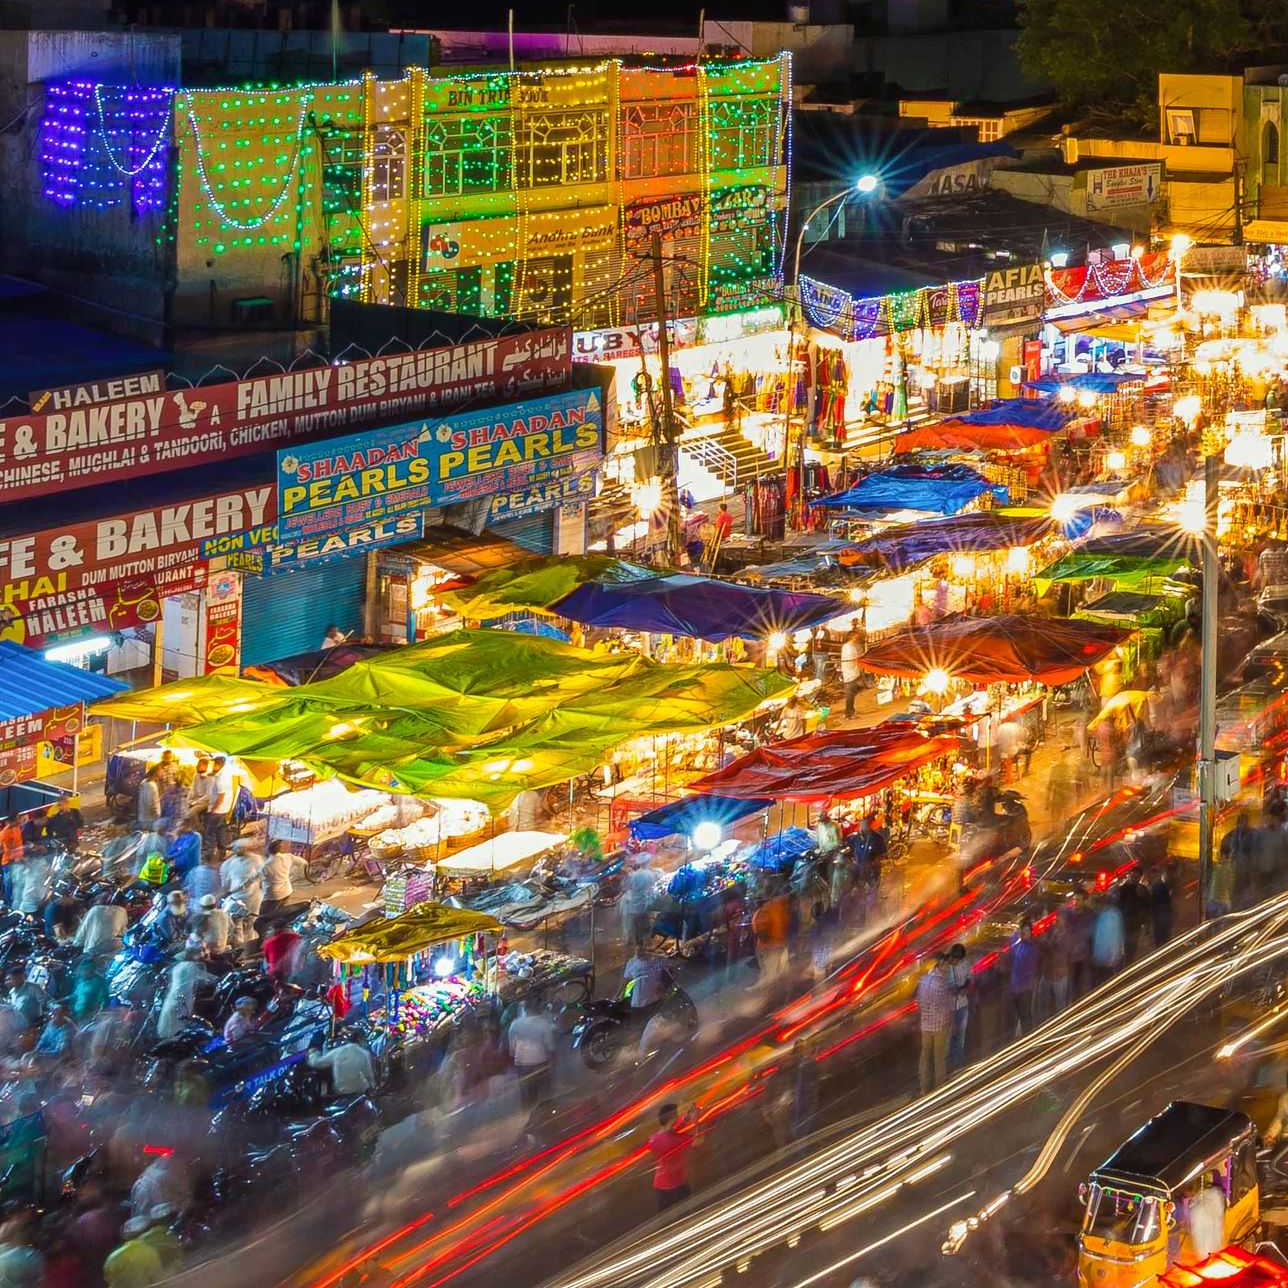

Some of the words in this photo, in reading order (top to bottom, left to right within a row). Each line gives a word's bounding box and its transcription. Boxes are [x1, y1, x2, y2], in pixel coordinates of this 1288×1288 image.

[449, 91, 473, 106] BIN
[641, 198, 700, 225] BOMBAY
[529, 228, 577, 244] Andhra
[581, 224, 614, 240] Bank
[987, 283, 1044, 305] PEARLS
[988, 264, 1043, 291] AFIA
[13, 425, 38, 461] &
[46, 397, 166, 455] BAKERY
[210, 405, 221, 426] A
[237, 368, 331, 420] FAMILY
[338, 340, 498, 401] RESTAURANT
[54, 374, 161, 410] HALEEM
[69, 448, 135, 477] MUGHLAI
[140, 445, 149, 463] &
[154, 430, 226, 458] TANDOORI,
[230, 420, 291, 446] CHICKEN,
[294, 409, 346, 433] MUTTON
[350, 403, 376, 422] DUM
[379, 393, 425, 416] BIRYANI
[451, 406, 586, 451] SHAADAN
[297, 439, 419, 483] SHAADAN
[440, 423, 598, 480] PEARLS
[283, 458, 430, 512] PEARLS
[492, 470, 594, 513] PEARLS
[48, 535, 84, 570] &
[96, 487, 273, 561] BAKERY
[204, 534, 243, 556] NON
[271, 518, 417, 565] PEARLS
[0, 572, 67, 603] HAI
[82, 569, 107, 586] DUM
[109, 557, 154, 579] MUTTON
[27, 598, 107, 636] HALEEM
[29, 587, 97, 611] FARASHA
[0, 718, 43, 741] EEM
